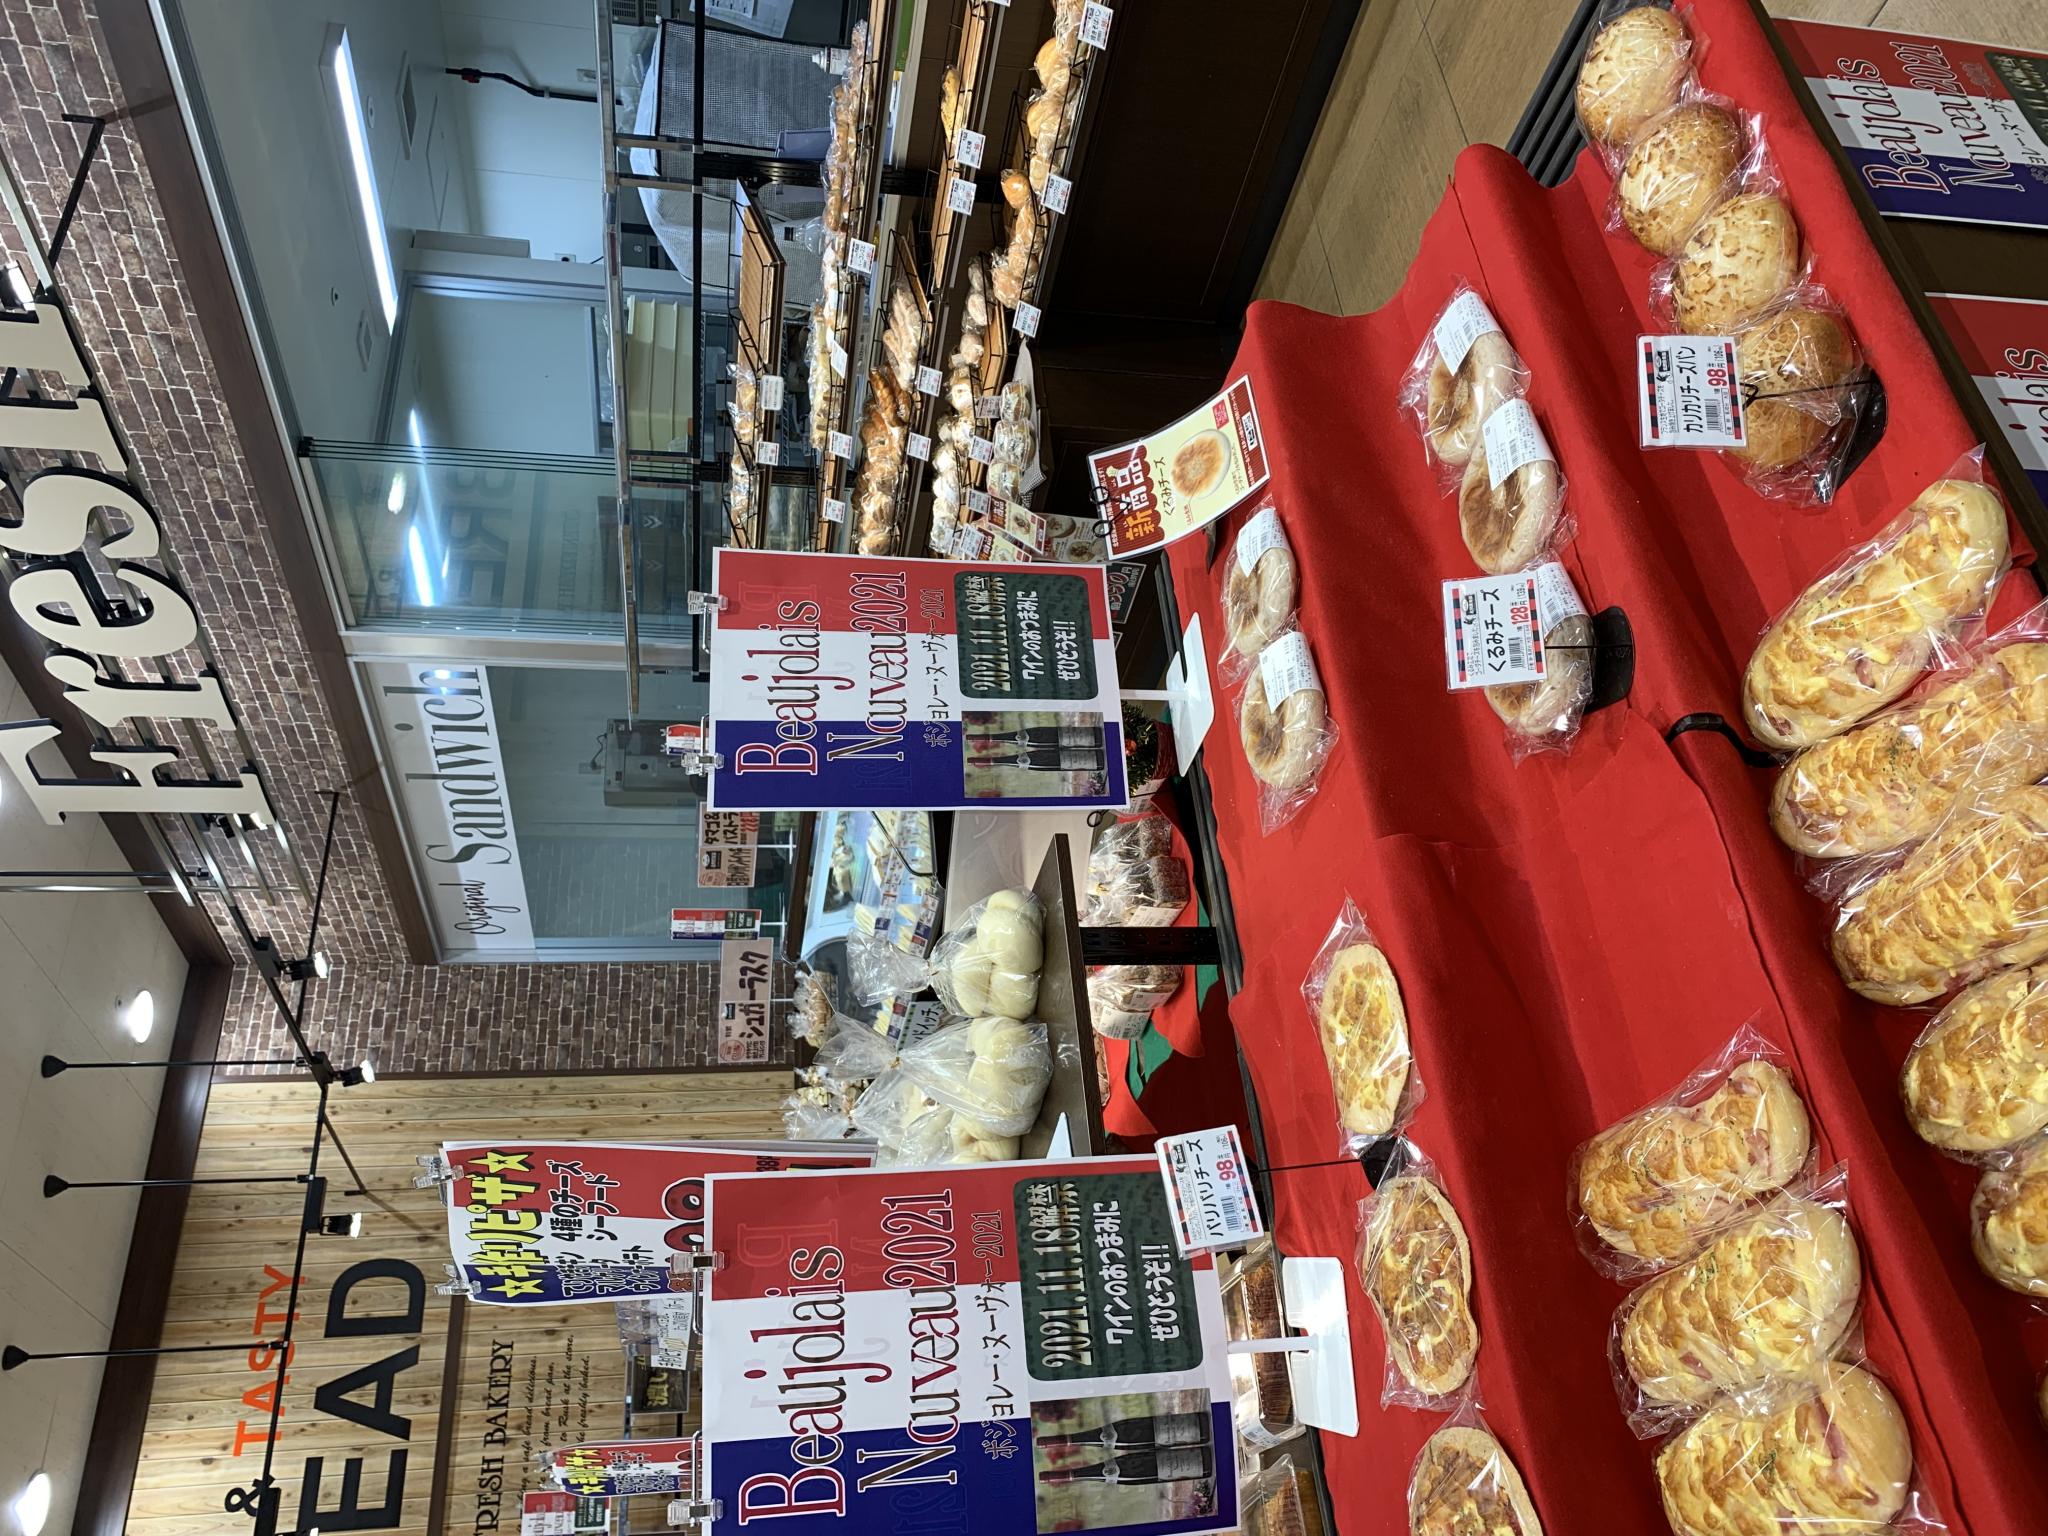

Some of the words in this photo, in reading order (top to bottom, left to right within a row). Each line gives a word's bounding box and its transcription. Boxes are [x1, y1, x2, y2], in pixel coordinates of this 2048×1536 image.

[1889, 41, 1967, 96] 2021
[1826, 57, 1950, 195] Beaujolais
[1934, 89, 2026, 192] Nouveau
[1676, 346, 1704, 433] カリカリチーズパン
[1706, 368, 1728, 386] 98
[1114, 458, 1155, 541] 新商品
[1153, 456, 1176, 516] くるみチーズ
[850, 571, 907, 632] 2021
[1016, 590, 1045, 681] ワインのおつまみに
[1480, 587, 1507, 672] くるみチーズ
[1510, 606, 1530, 625] 128
[735, 599, 855, 776] Beaujolais
[827, 631, 908, 761] Nouveau
[382, 668, 512, 865] Sandwich
[438, 879, 520, 935] Original
[738, 950, 769, 1038] シュガーラスク
[546, 1159, 586, 1242] 4種のチーズ
[584, 1172, 620, 1241] シーフード
[1186, 1138, 1224, 1237] パリパリチーズ
[881, 1188, 958, 1286] 2021
[1027, 1181, 1094, 1368] 2021.11.18解禁
[1094, 1198, 1135, 1345] ワインのおつまみに
[233, 1264, 311, 1456] TASTY
[525, 1355, 538, 1403] delicious.
[545, 1361, 556, 1384] pan.
[562, 1364, 573, 1379] the
[562, 1382, 571, 1394] at
[563, 1334, 575, 1361] store.
[577, 1355, 590, 1388] baked.
[738, 1244, 893, 1524] Beaujolais
[856, 1284, 961, 1491] Nouveau
[297, 1258, 426, 1534] EAD
[483, 1339, 514, 1447] BAKERY
[523, 1407, 533, 1435] bread
[540, 1420, 552, 1447] from
[541, 1387, 552, 1416] bread
[558, 1398, 571, 1426] Rusk
[576, 1392, 591, 1427] freshly
[521, 1439, 532, 1462] safe
[559, 1431, 568, 1442] to
[473, 1455, 504, 1536] RESH
